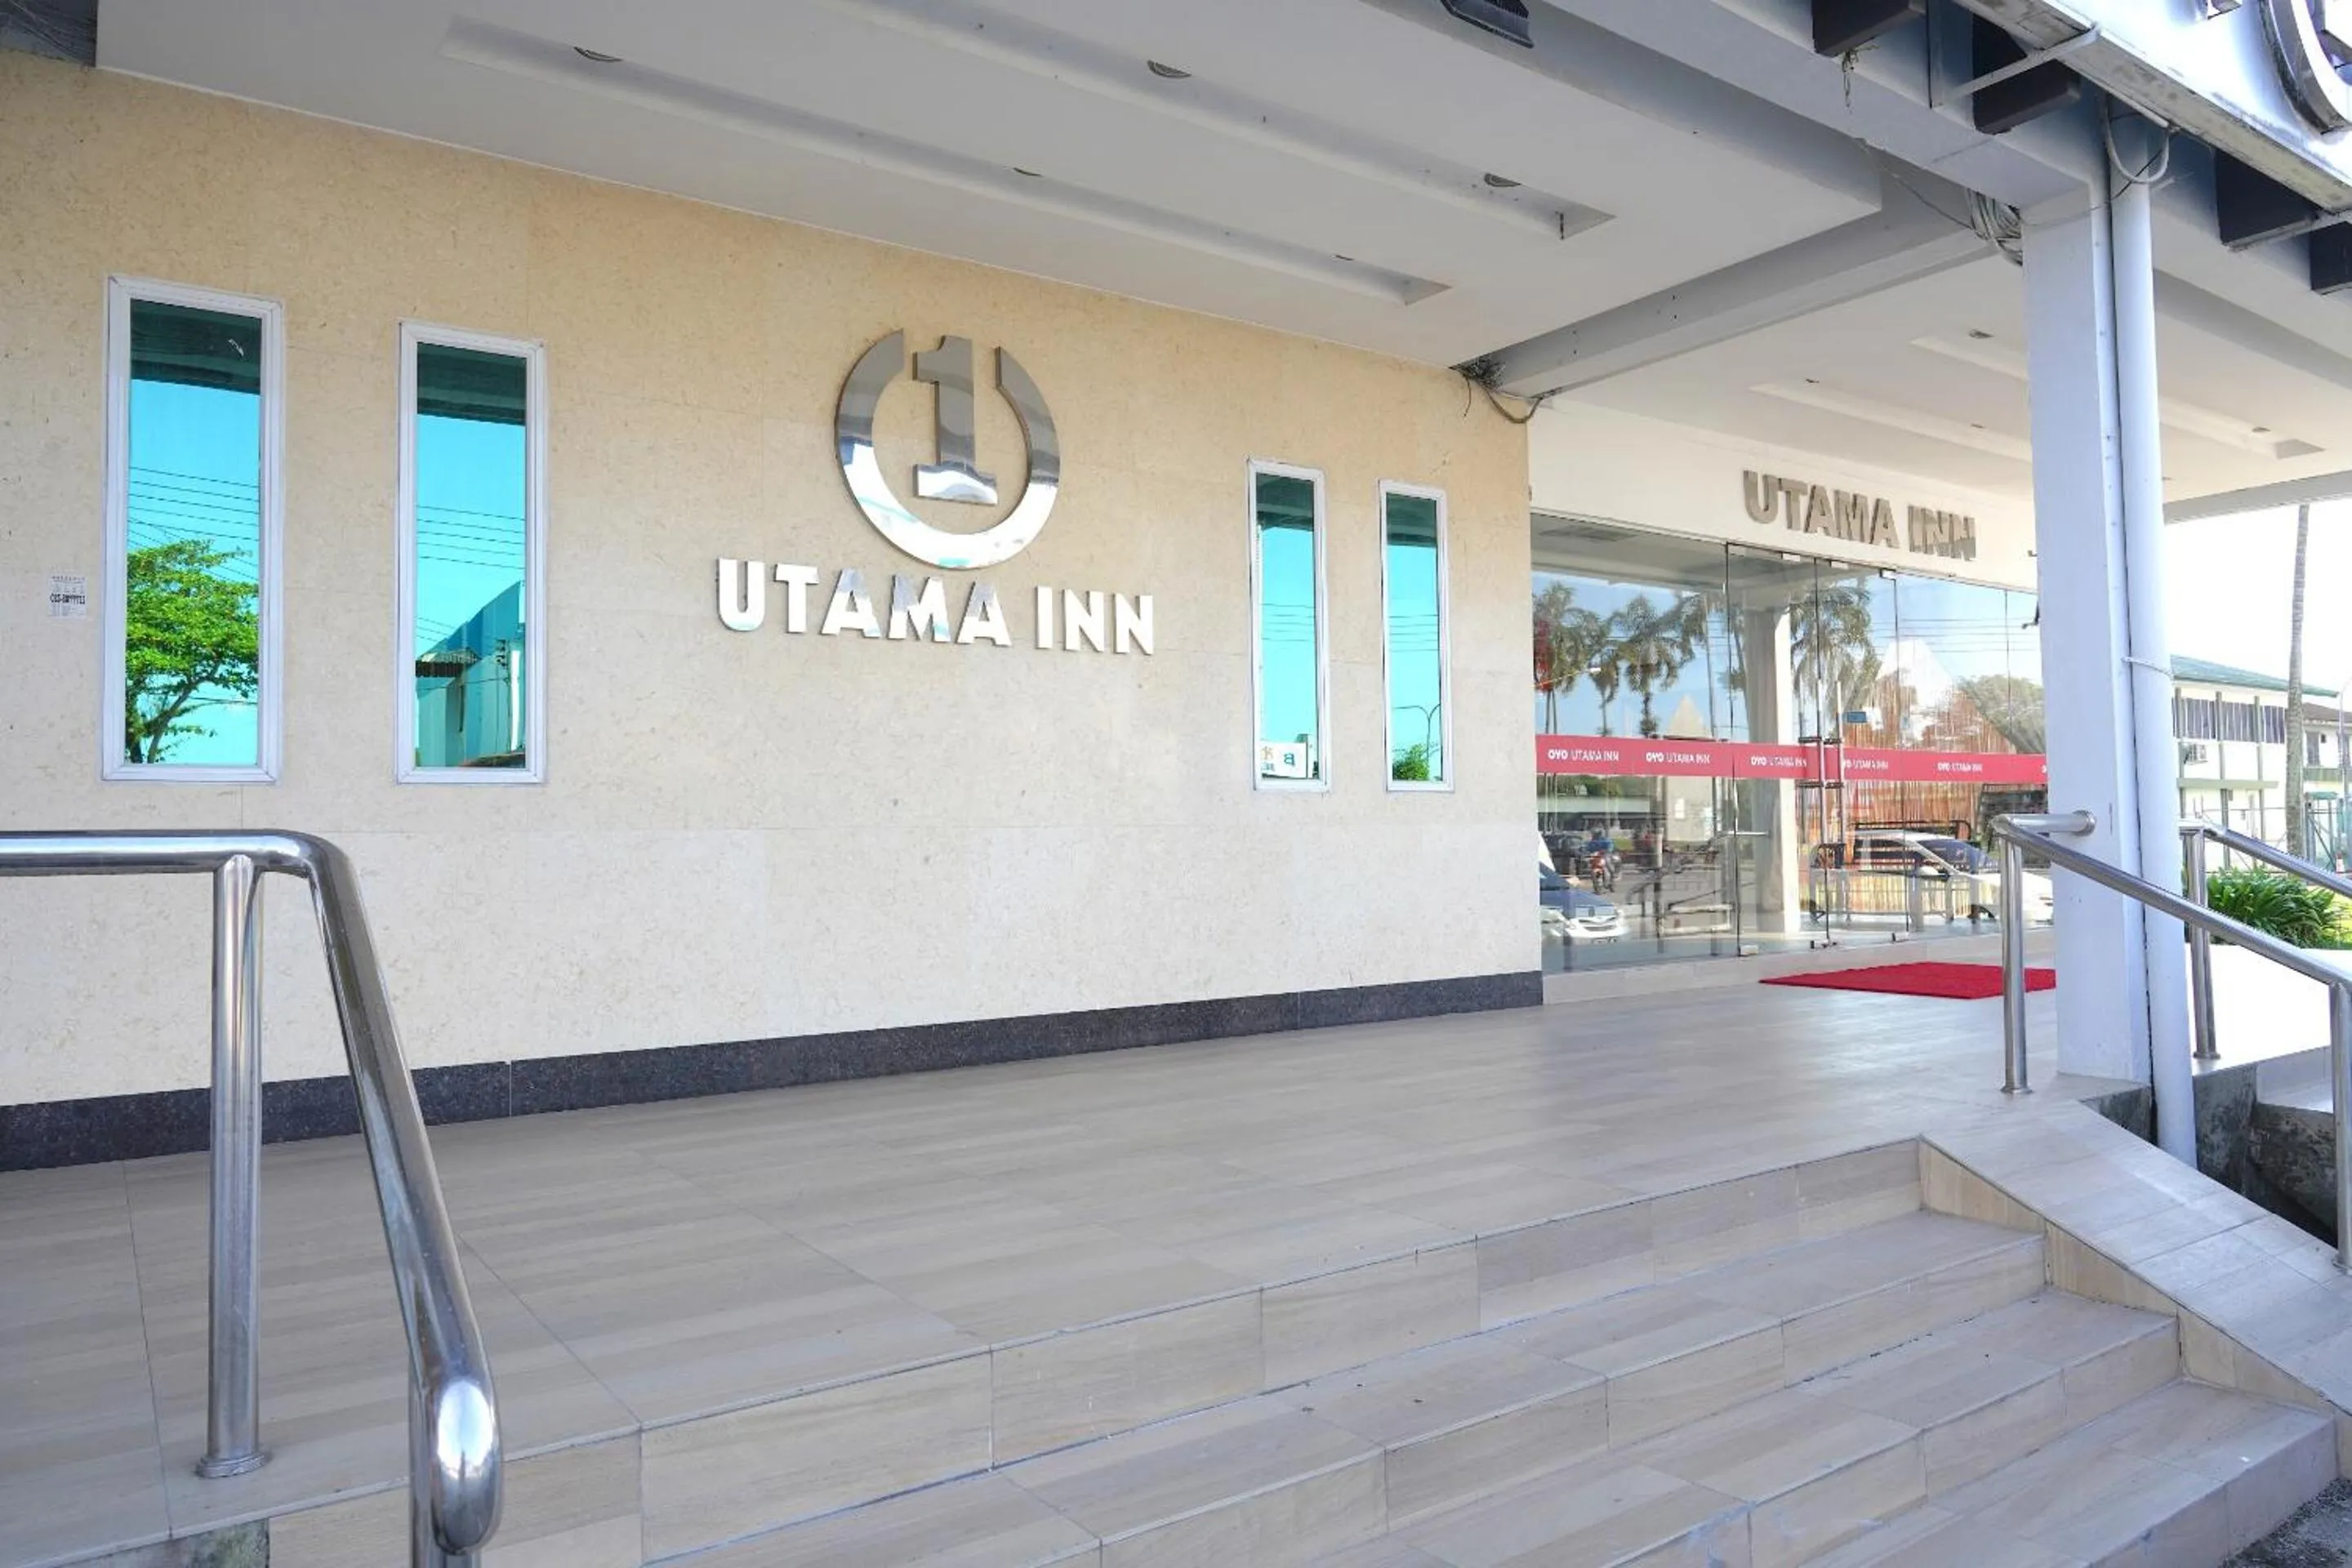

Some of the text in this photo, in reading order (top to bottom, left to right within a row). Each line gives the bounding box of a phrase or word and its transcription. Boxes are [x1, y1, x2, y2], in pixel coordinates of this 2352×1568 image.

[1743, 469, 1976, 561] UTAMA INN
[715, 558, 1153, 655] UTAMA INN
[1548, 748, 1619, 762] OYO UTAMA INN
[1646, 751, 1664, 763] OYO
[1750, 755, 1767, 766] OYO
